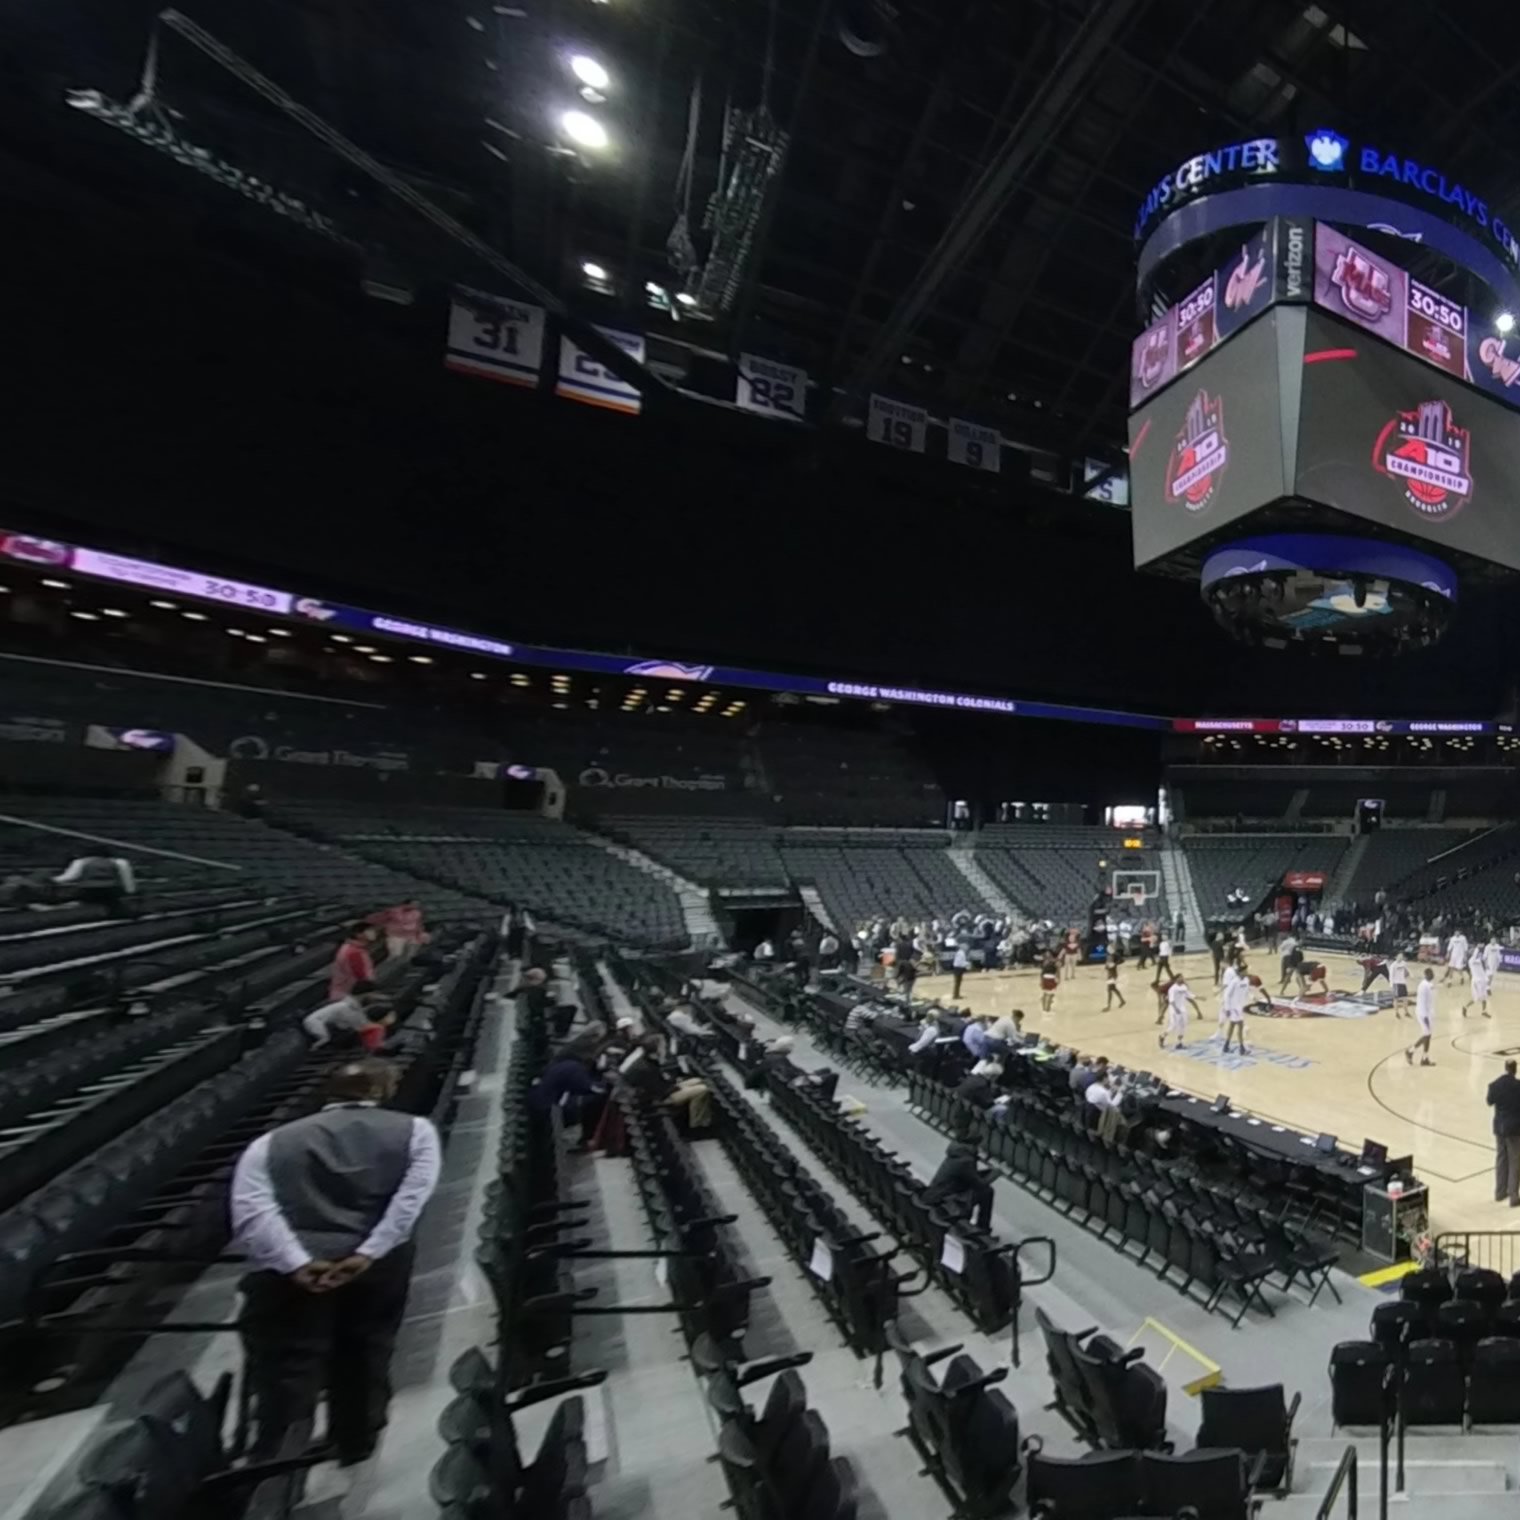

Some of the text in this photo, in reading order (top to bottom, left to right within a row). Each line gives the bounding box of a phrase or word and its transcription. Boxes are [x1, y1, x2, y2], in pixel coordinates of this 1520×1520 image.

[1175, 138, 1280, 190] CENTER
[1361, 147, 1488, 227] BARCLAYS
[1284, 227, 1304, 297] verizon
[1178, 287, 1214, 327] 30:50
[1410, 288, 1462, 331] 30:50
[473, 321, 520, 356] 31
[882, 417, 913, 449] 19
[966, 441, 984, 466] 9
[1395, 438, 1461, 475] A10
[1390, 459, 1463, 489] CHAMPIONSHIP
[827, 682, 1015, 713] GEORGE WASHINGTON COLONIALS
